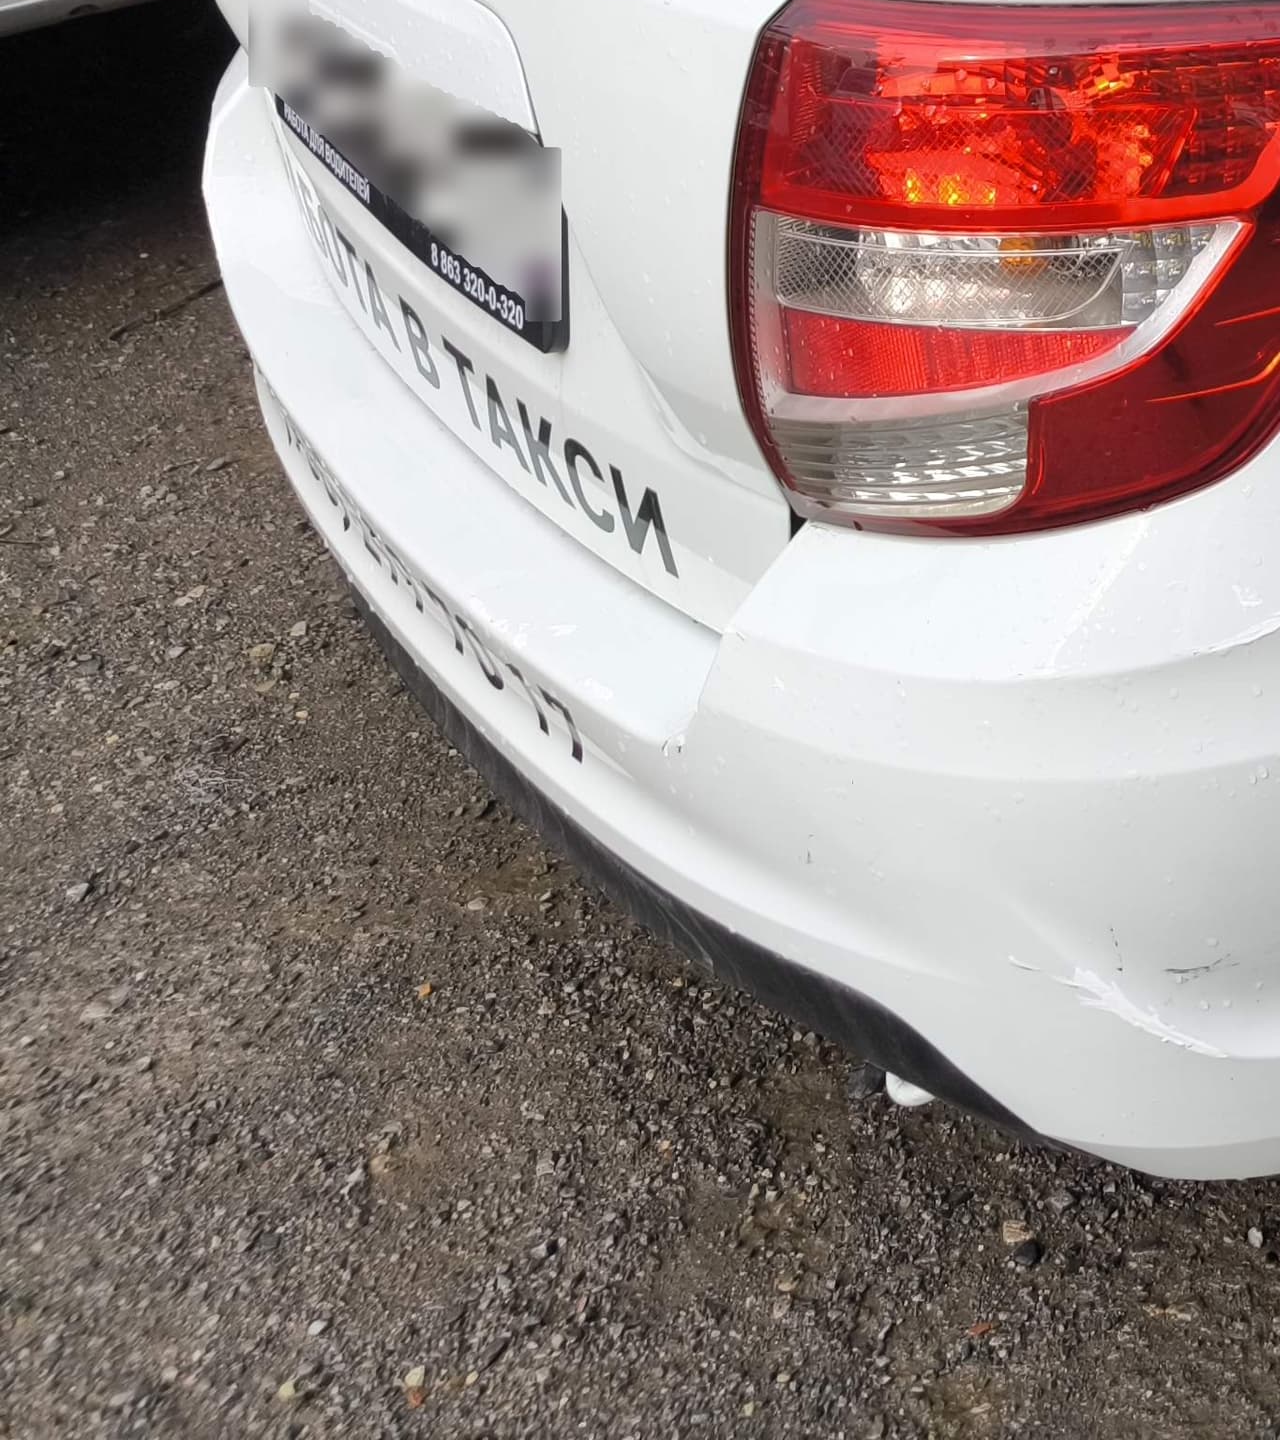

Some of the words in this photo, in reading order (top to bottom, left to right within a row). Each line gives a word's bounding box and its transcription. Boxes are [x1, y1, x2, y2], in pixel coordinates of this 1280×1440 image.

[325, 141, 370, 204] ВОДИТЕЛЕЙ
[431, 242, 439, 267] 8
[441, 250, 461, 285] 863
[463, 267, 524, 330] 320-0-320
[398, 294, 441, 388] В
[442, 334, 680, 580] ТАКСИ
